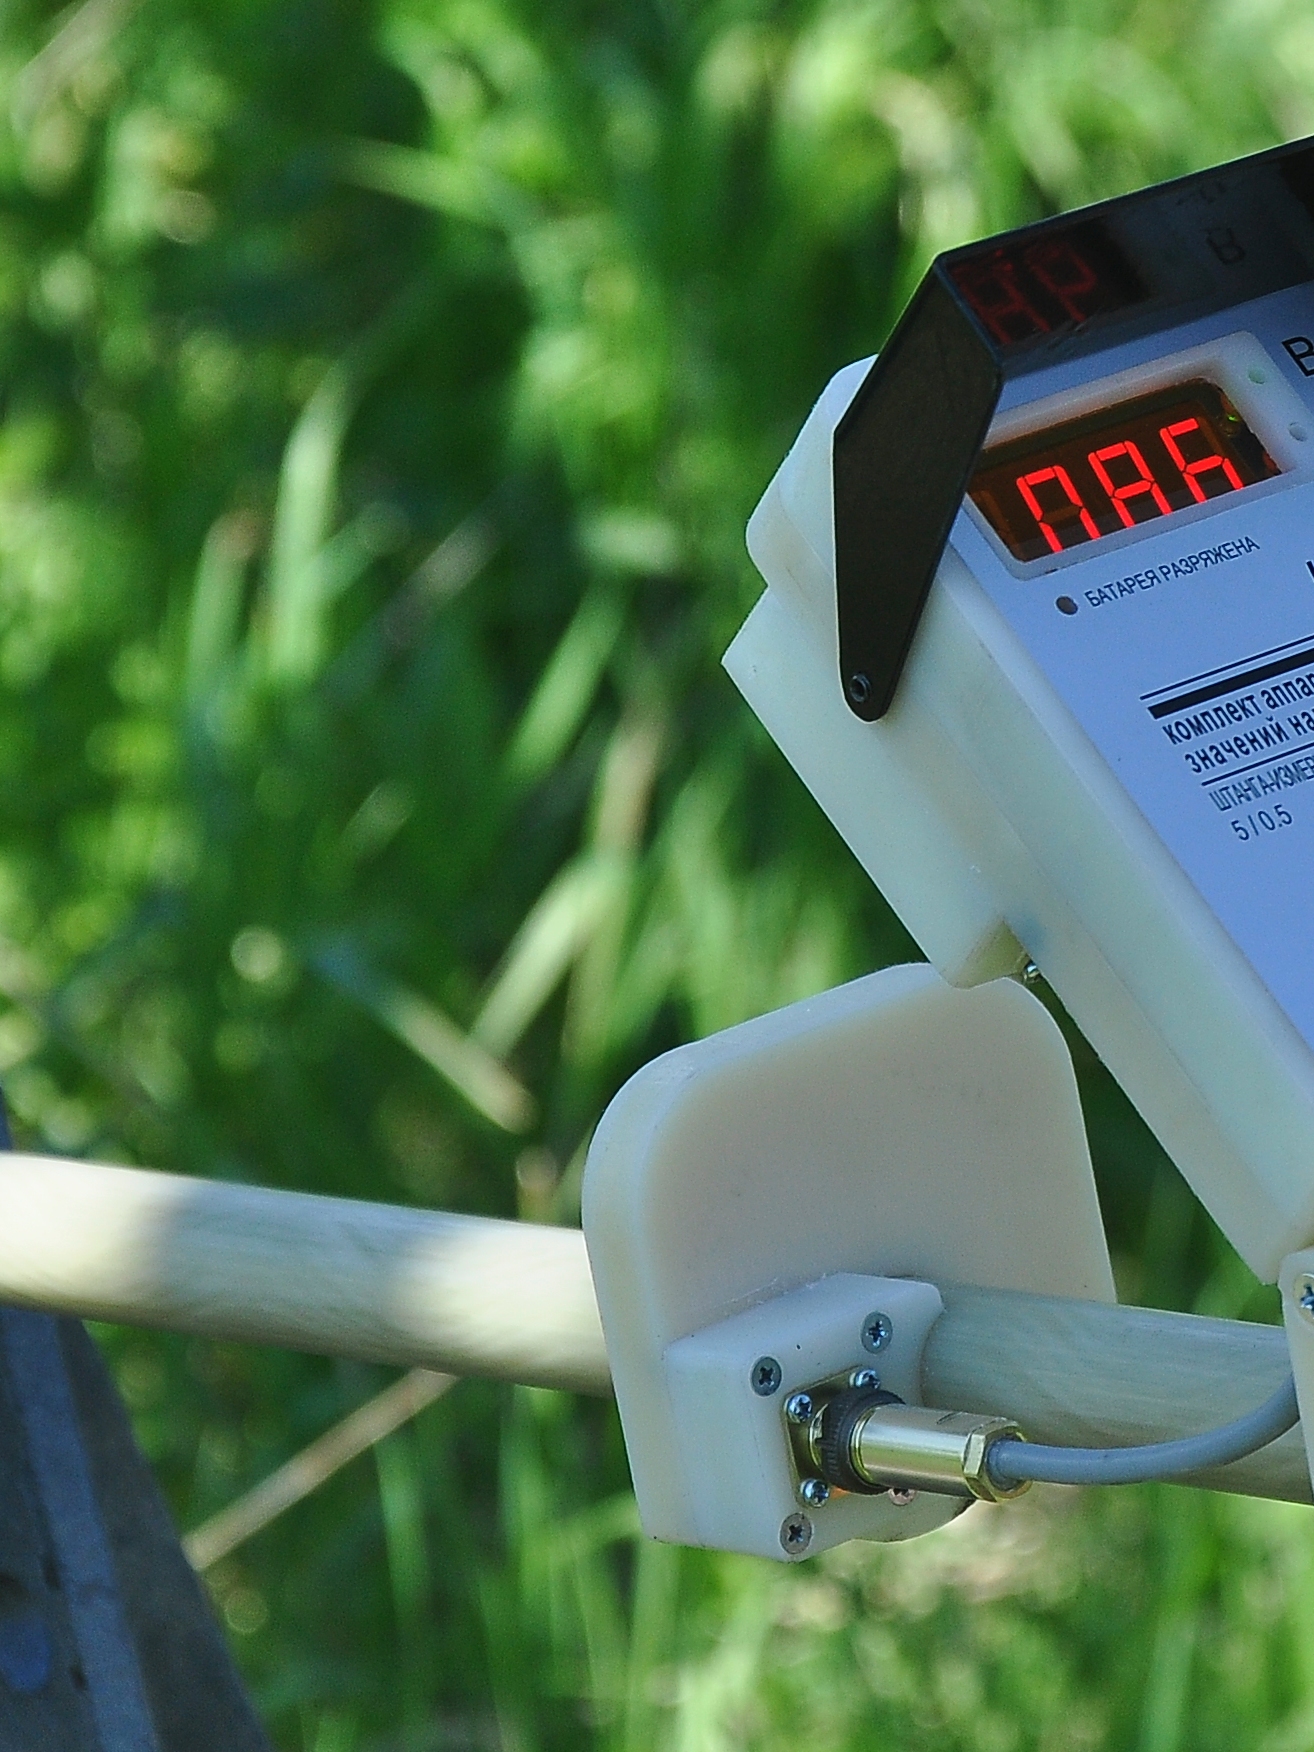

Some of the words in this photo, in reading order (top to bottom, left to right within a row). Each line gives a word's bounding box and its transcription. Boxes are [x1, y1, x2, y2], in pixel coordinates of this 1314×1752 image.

[1084, 569, 1162, 608] БАТАРЕЯ
[1158, 536, 1261, 582] РАЗРЯЖЕНА
[1162, 694, 1262, 745] комплект
[1185, 715, 1290, 774] значений
